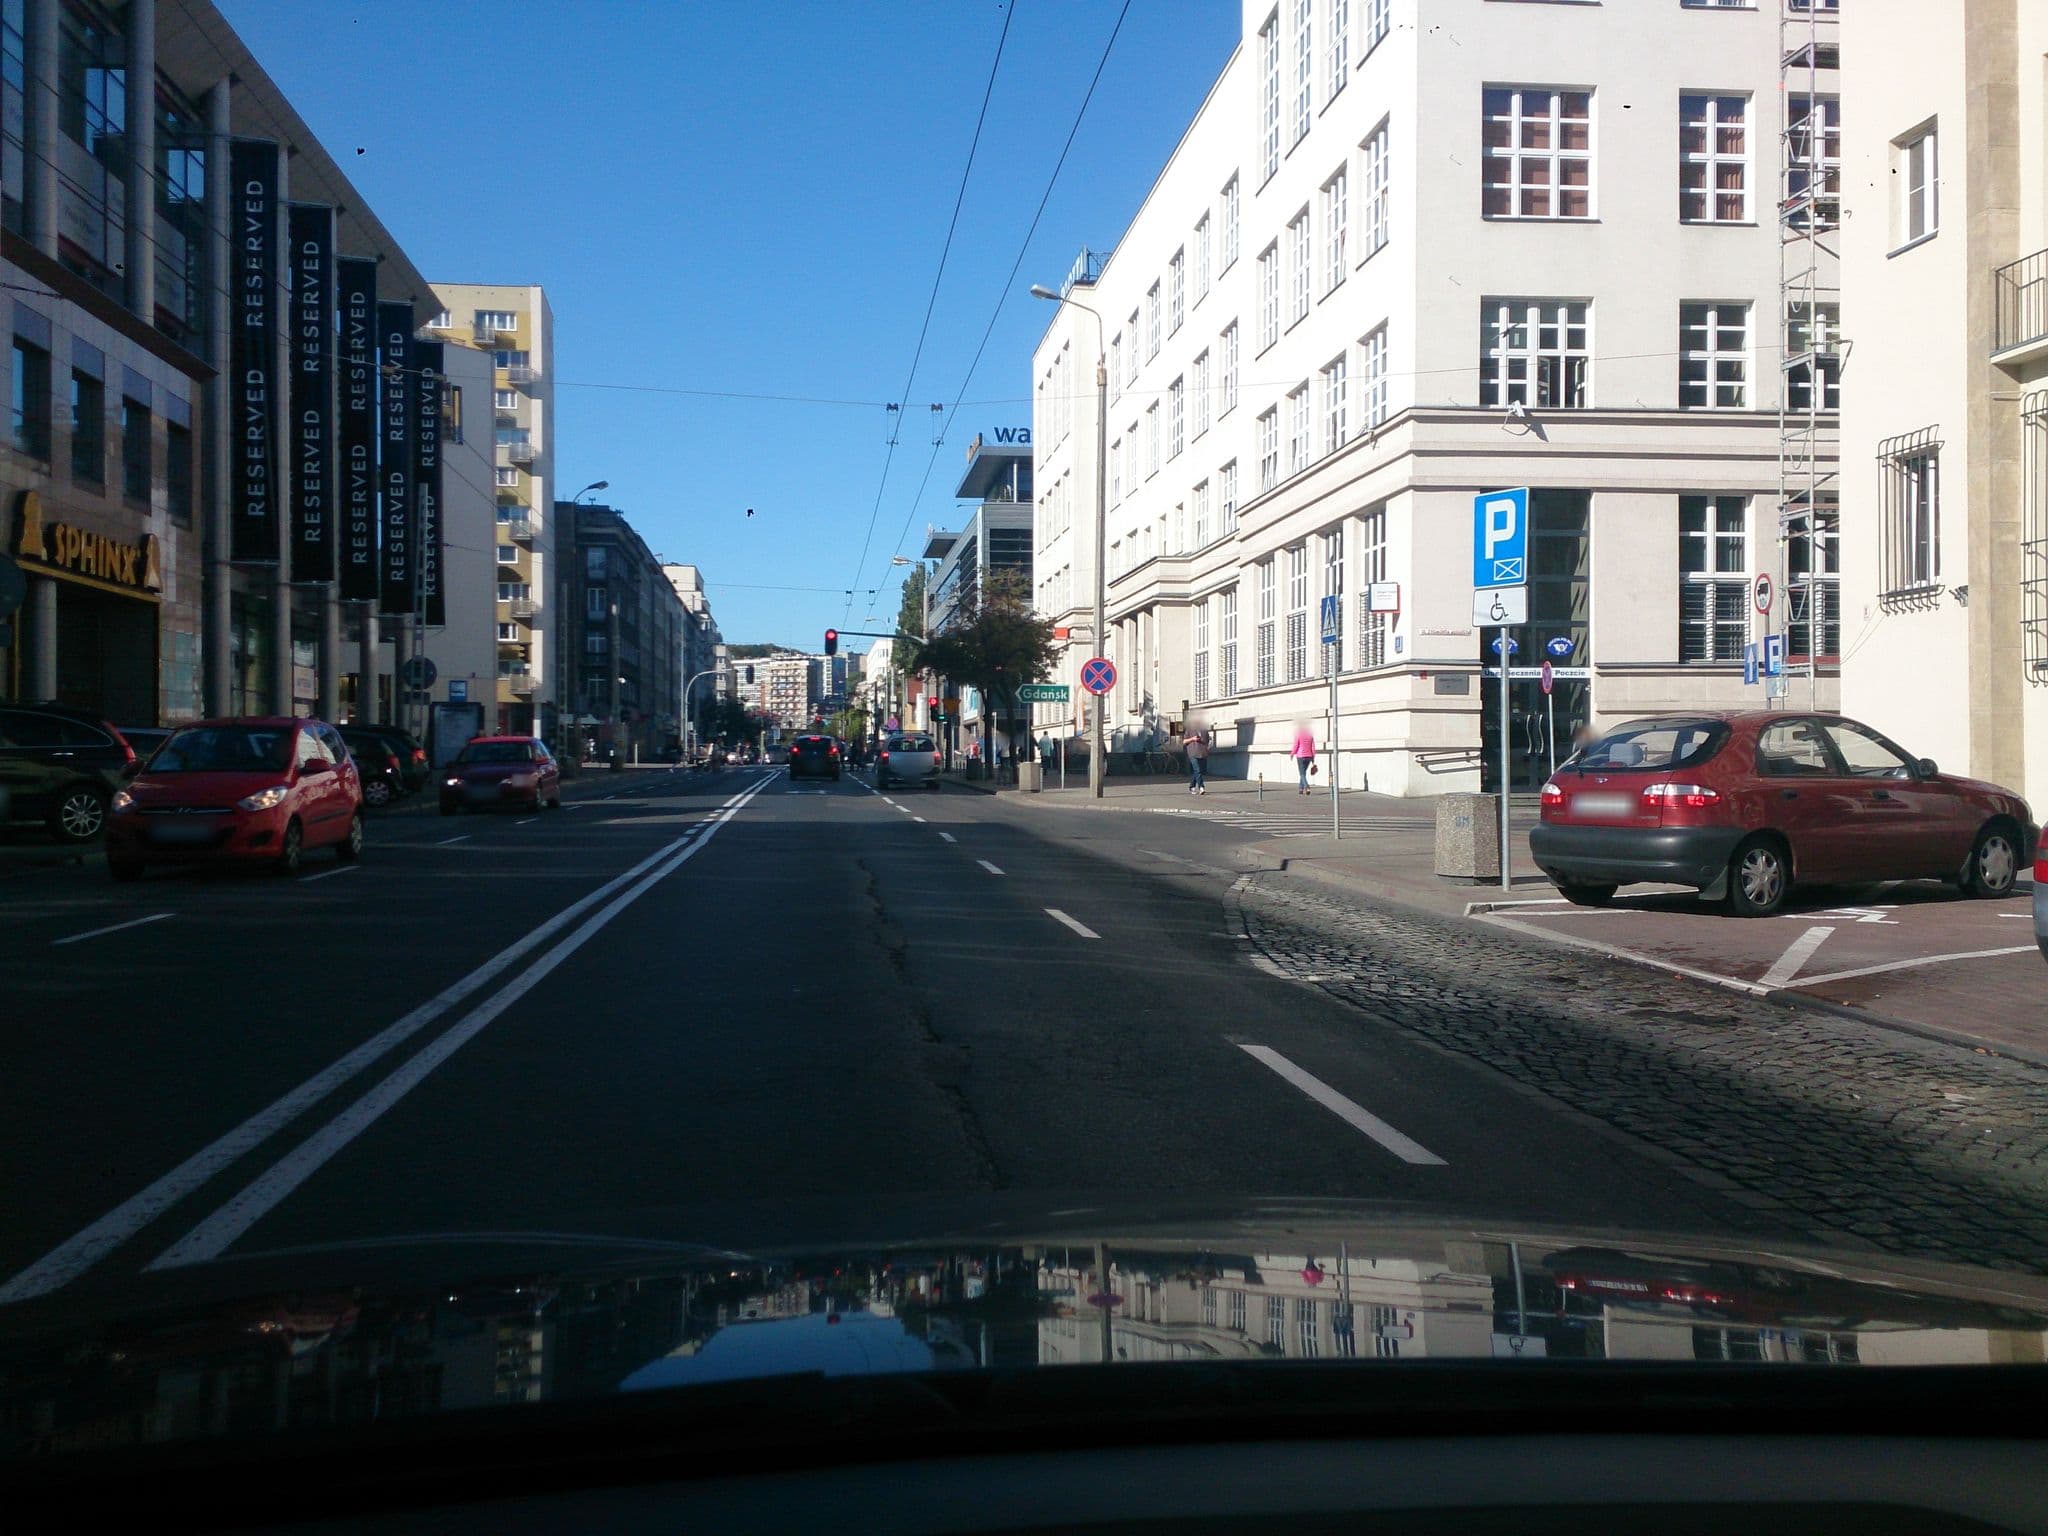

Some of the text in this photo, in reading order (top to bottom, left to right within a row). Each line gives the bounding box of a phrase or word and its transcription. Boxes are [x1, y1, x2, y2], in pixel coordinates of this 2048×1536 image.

[246, 181, 264, 326] RESERVED
[303, 241, 320, 372] RESERVED
[351, 292, 366, 410] RESERVED
[389, 332, 404, 441] RESERVED
[246, 369, 265, 516] RESERVED
[422, 367, 435, 467] RESERVED
[303, 410, 321, 542] RESERVED
[351, 445, 367, 563] RESERVED
[390, 472, 405, 581] RESERVED
[1485, 499, 1516, 560] P
[54, 523, 137, 586] SPHINX
[425, 496, 436, 596] RESERVED
[1022, 688, 1068, 700] Gdańsk
[1555, 669, 1586, 677] Poczcie
